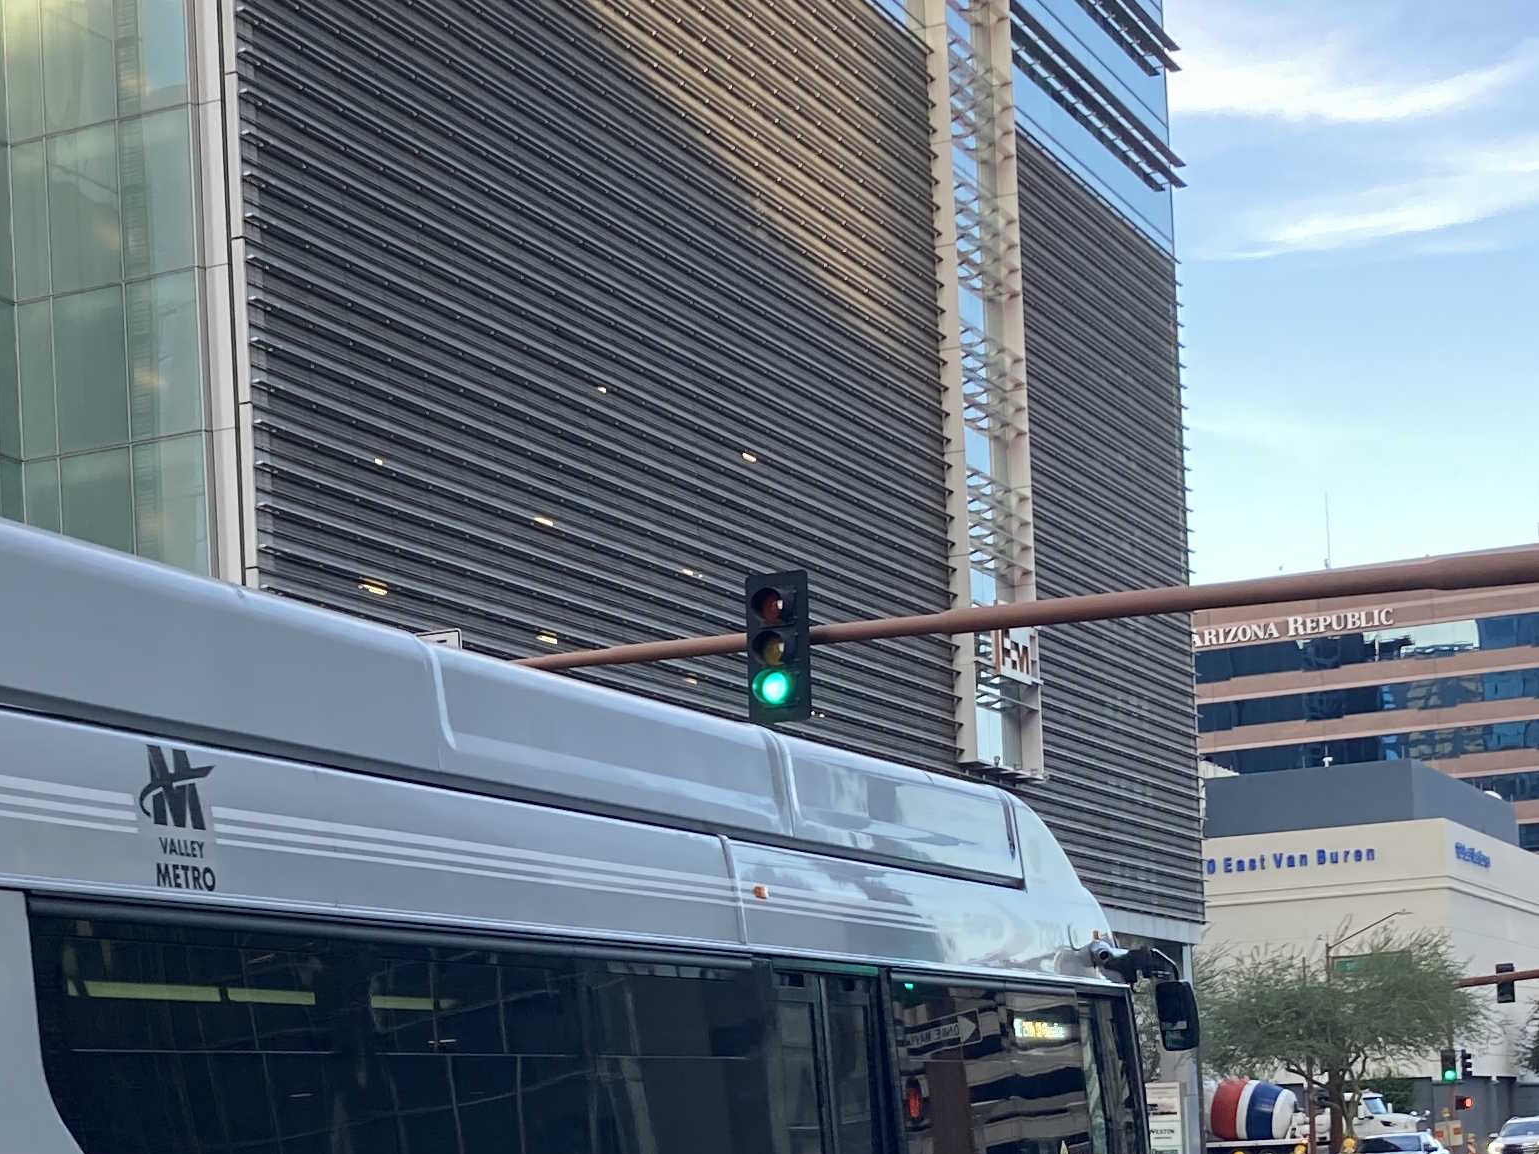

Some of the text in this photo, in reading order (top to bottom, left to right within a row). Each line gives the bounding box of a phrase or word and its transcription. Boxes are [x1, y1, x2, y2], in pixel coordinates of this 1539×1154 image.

[1192, 607, 1394, 648] ARIZONA REPUBLIC
[159, 836, 205, 859] VALLEY
[1224, 852, 1266, 873] East
[1273, 850, 1308, 869] Van
[1317, 847, 1376, 866] Buren
[156, 862, 216, 892] METRO
